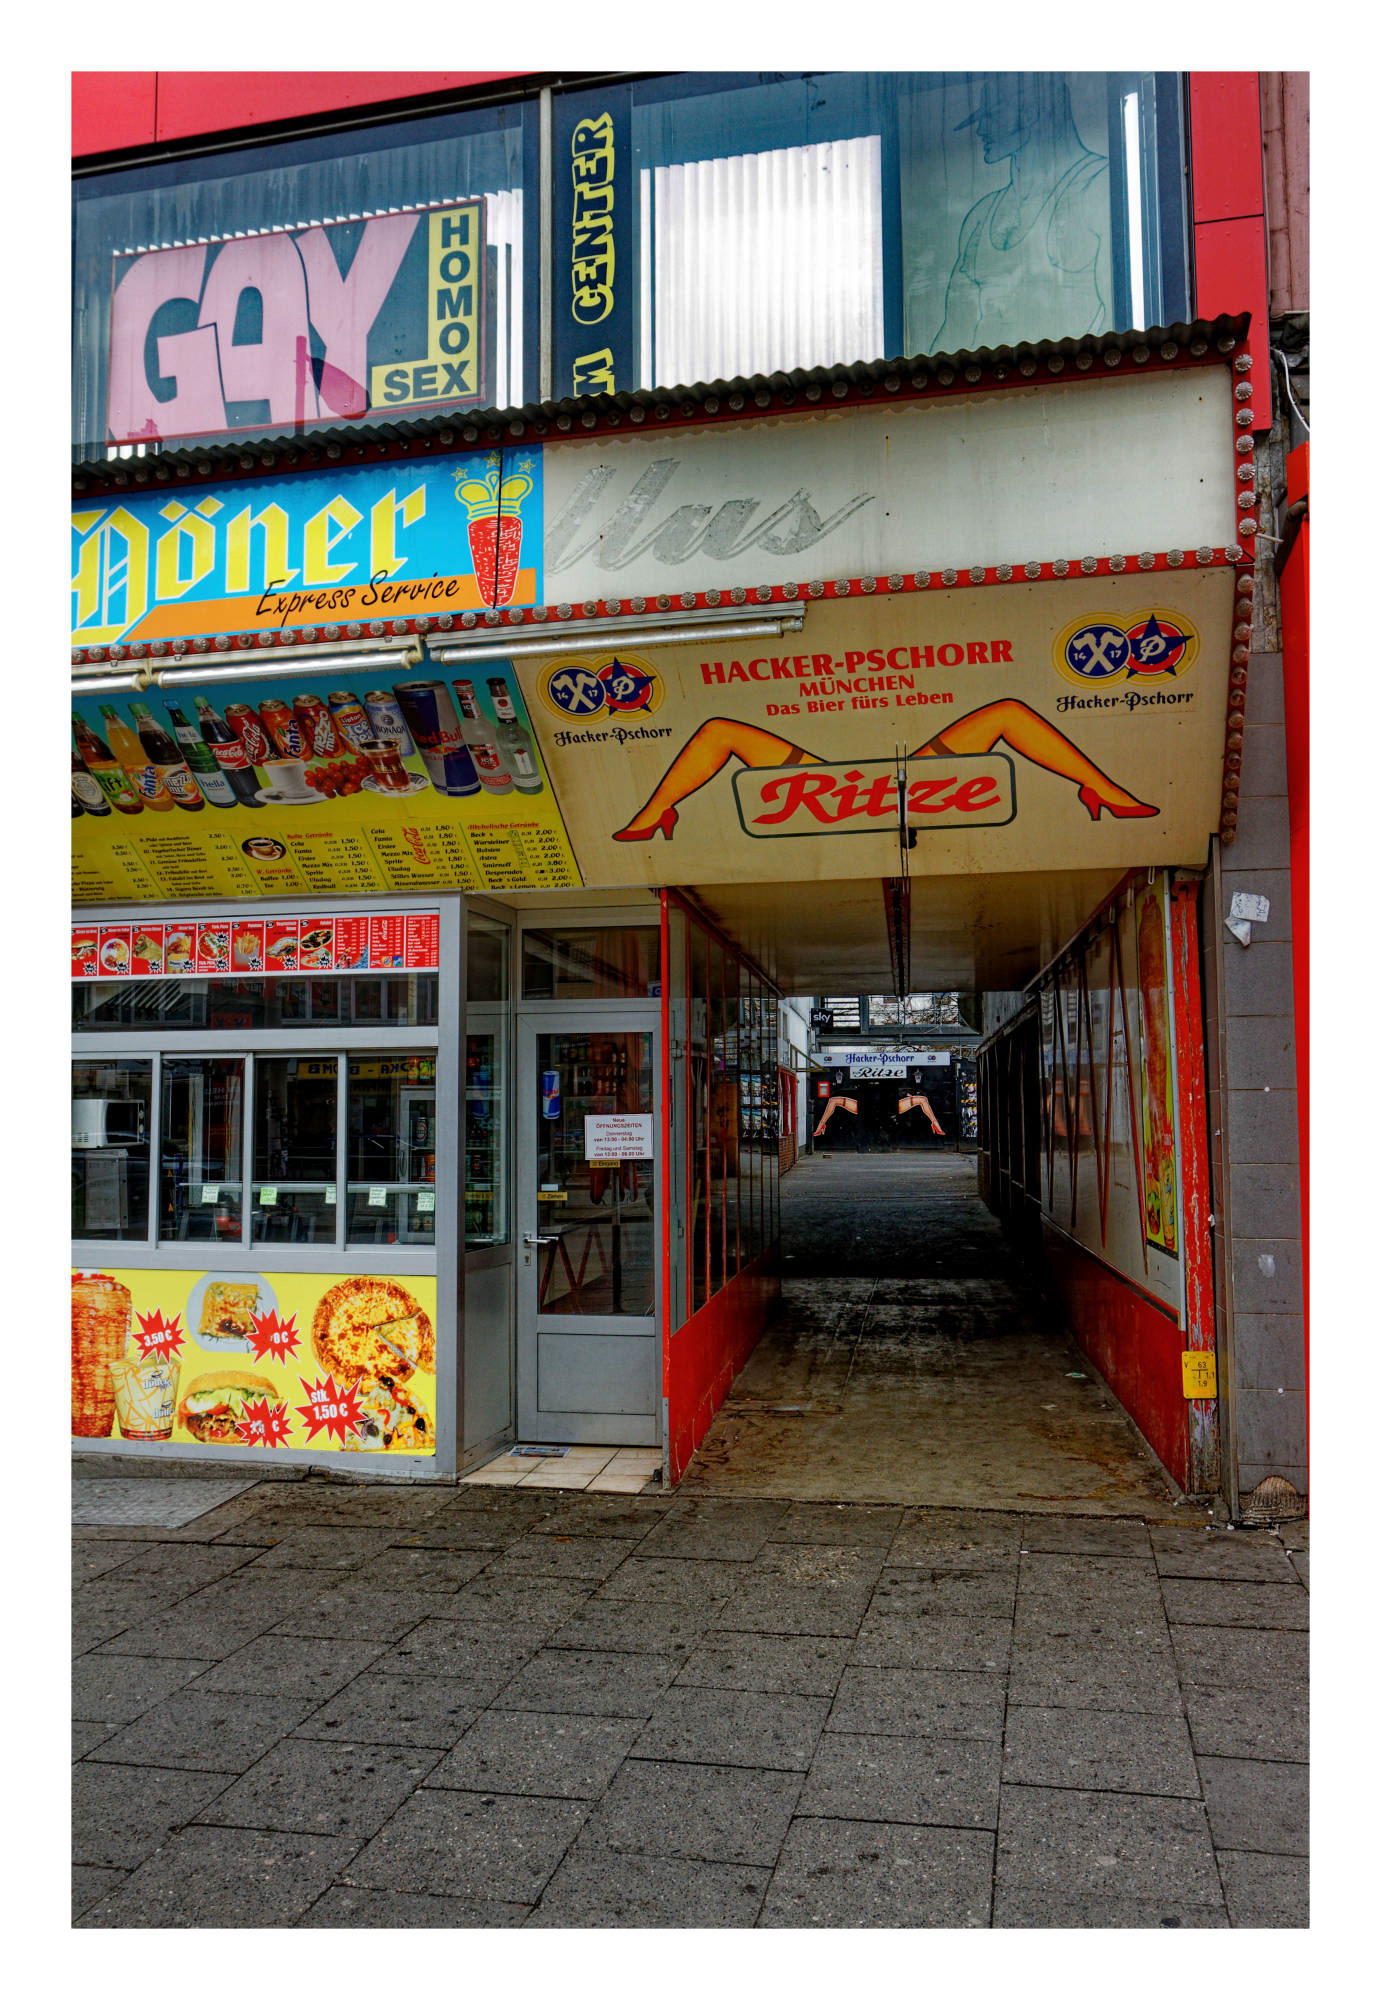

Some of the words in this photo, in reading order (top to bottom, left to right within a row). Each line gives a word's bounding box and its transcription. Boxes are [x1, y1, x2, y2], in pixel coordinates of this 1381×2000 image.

[572, 112, 615, 324] CENTER
[435, 214, 471, 355] HOMO
[108, 213, 421, 443] GAY
[384, 359, 470, 401] SEX
[72, 484, 426, 646] Döner
[256, 579, 356, 626] Express
[362, 570, 461, 607] Service
[700, 641, 1013, 685] HACKER-PSCHORR
[1074, 651, 1087, 662] 14
[1109, 645, 1122, 656] 17
[556, 692, 569, 700] 14
[588, 689, 598, 698] 17
[800, 673, 915, 697] MÜNCHEN
[766, 699, 803, 717] Das
[807, 696, 845, 714] Bier
[851, 693, 890, 711] fürs
[896, 690, 954, 707] Leben
[1056, 689, 1194, 712] Hacker-Pschorr
[554, 723, 672, 748] Hacker-Pschorr
[752, 770, 1002, 825] Ritze
[813, 1011, 831, 1023] sky
[845, 1053, 914, 1065] Hacker-Pschorr
[144, 1331, 164, 1347] 3,50
[313, 1404, 338, 1421] 1,50
[339, 1403, 349, 1417] €
